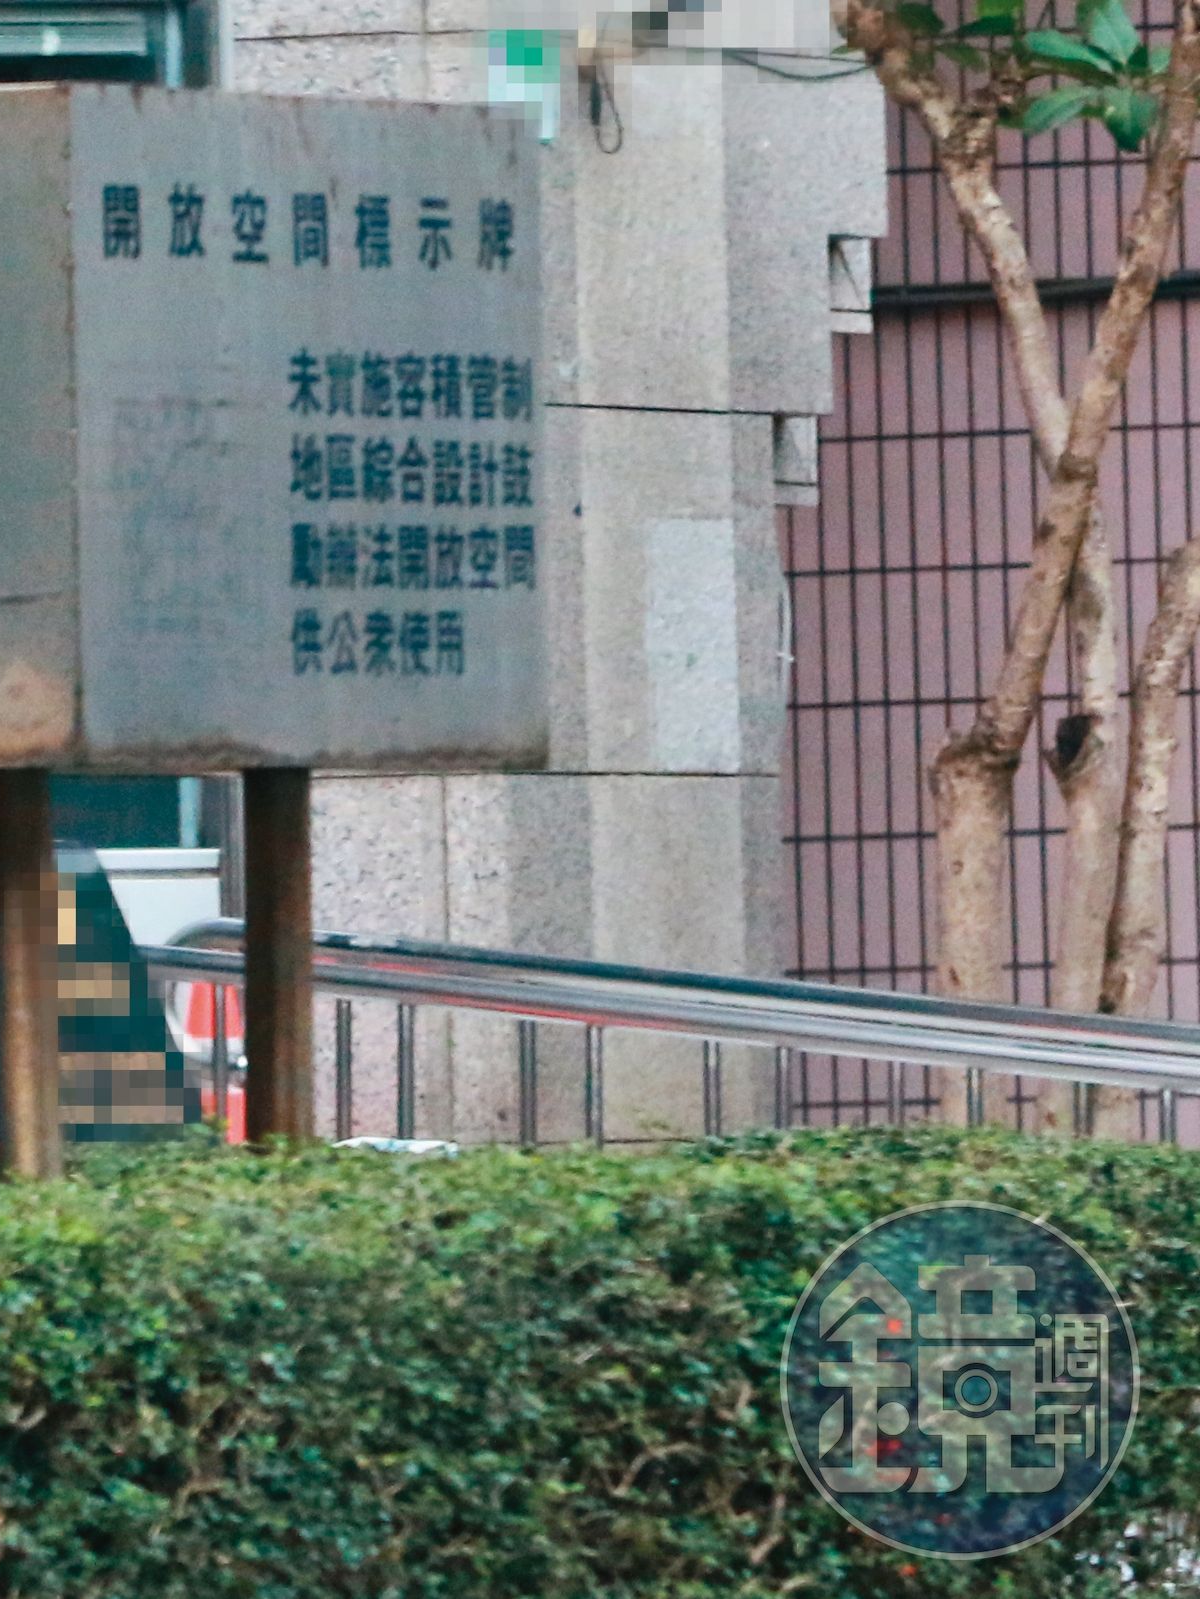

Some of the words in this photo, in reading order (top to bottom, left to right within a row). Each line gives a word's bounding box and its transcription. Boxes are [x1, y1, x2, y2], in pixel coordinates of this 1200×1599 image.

[103, 184, 514, 271] 開放空間標示牌
[288, 348, 533, 420] 未實施容積管制
